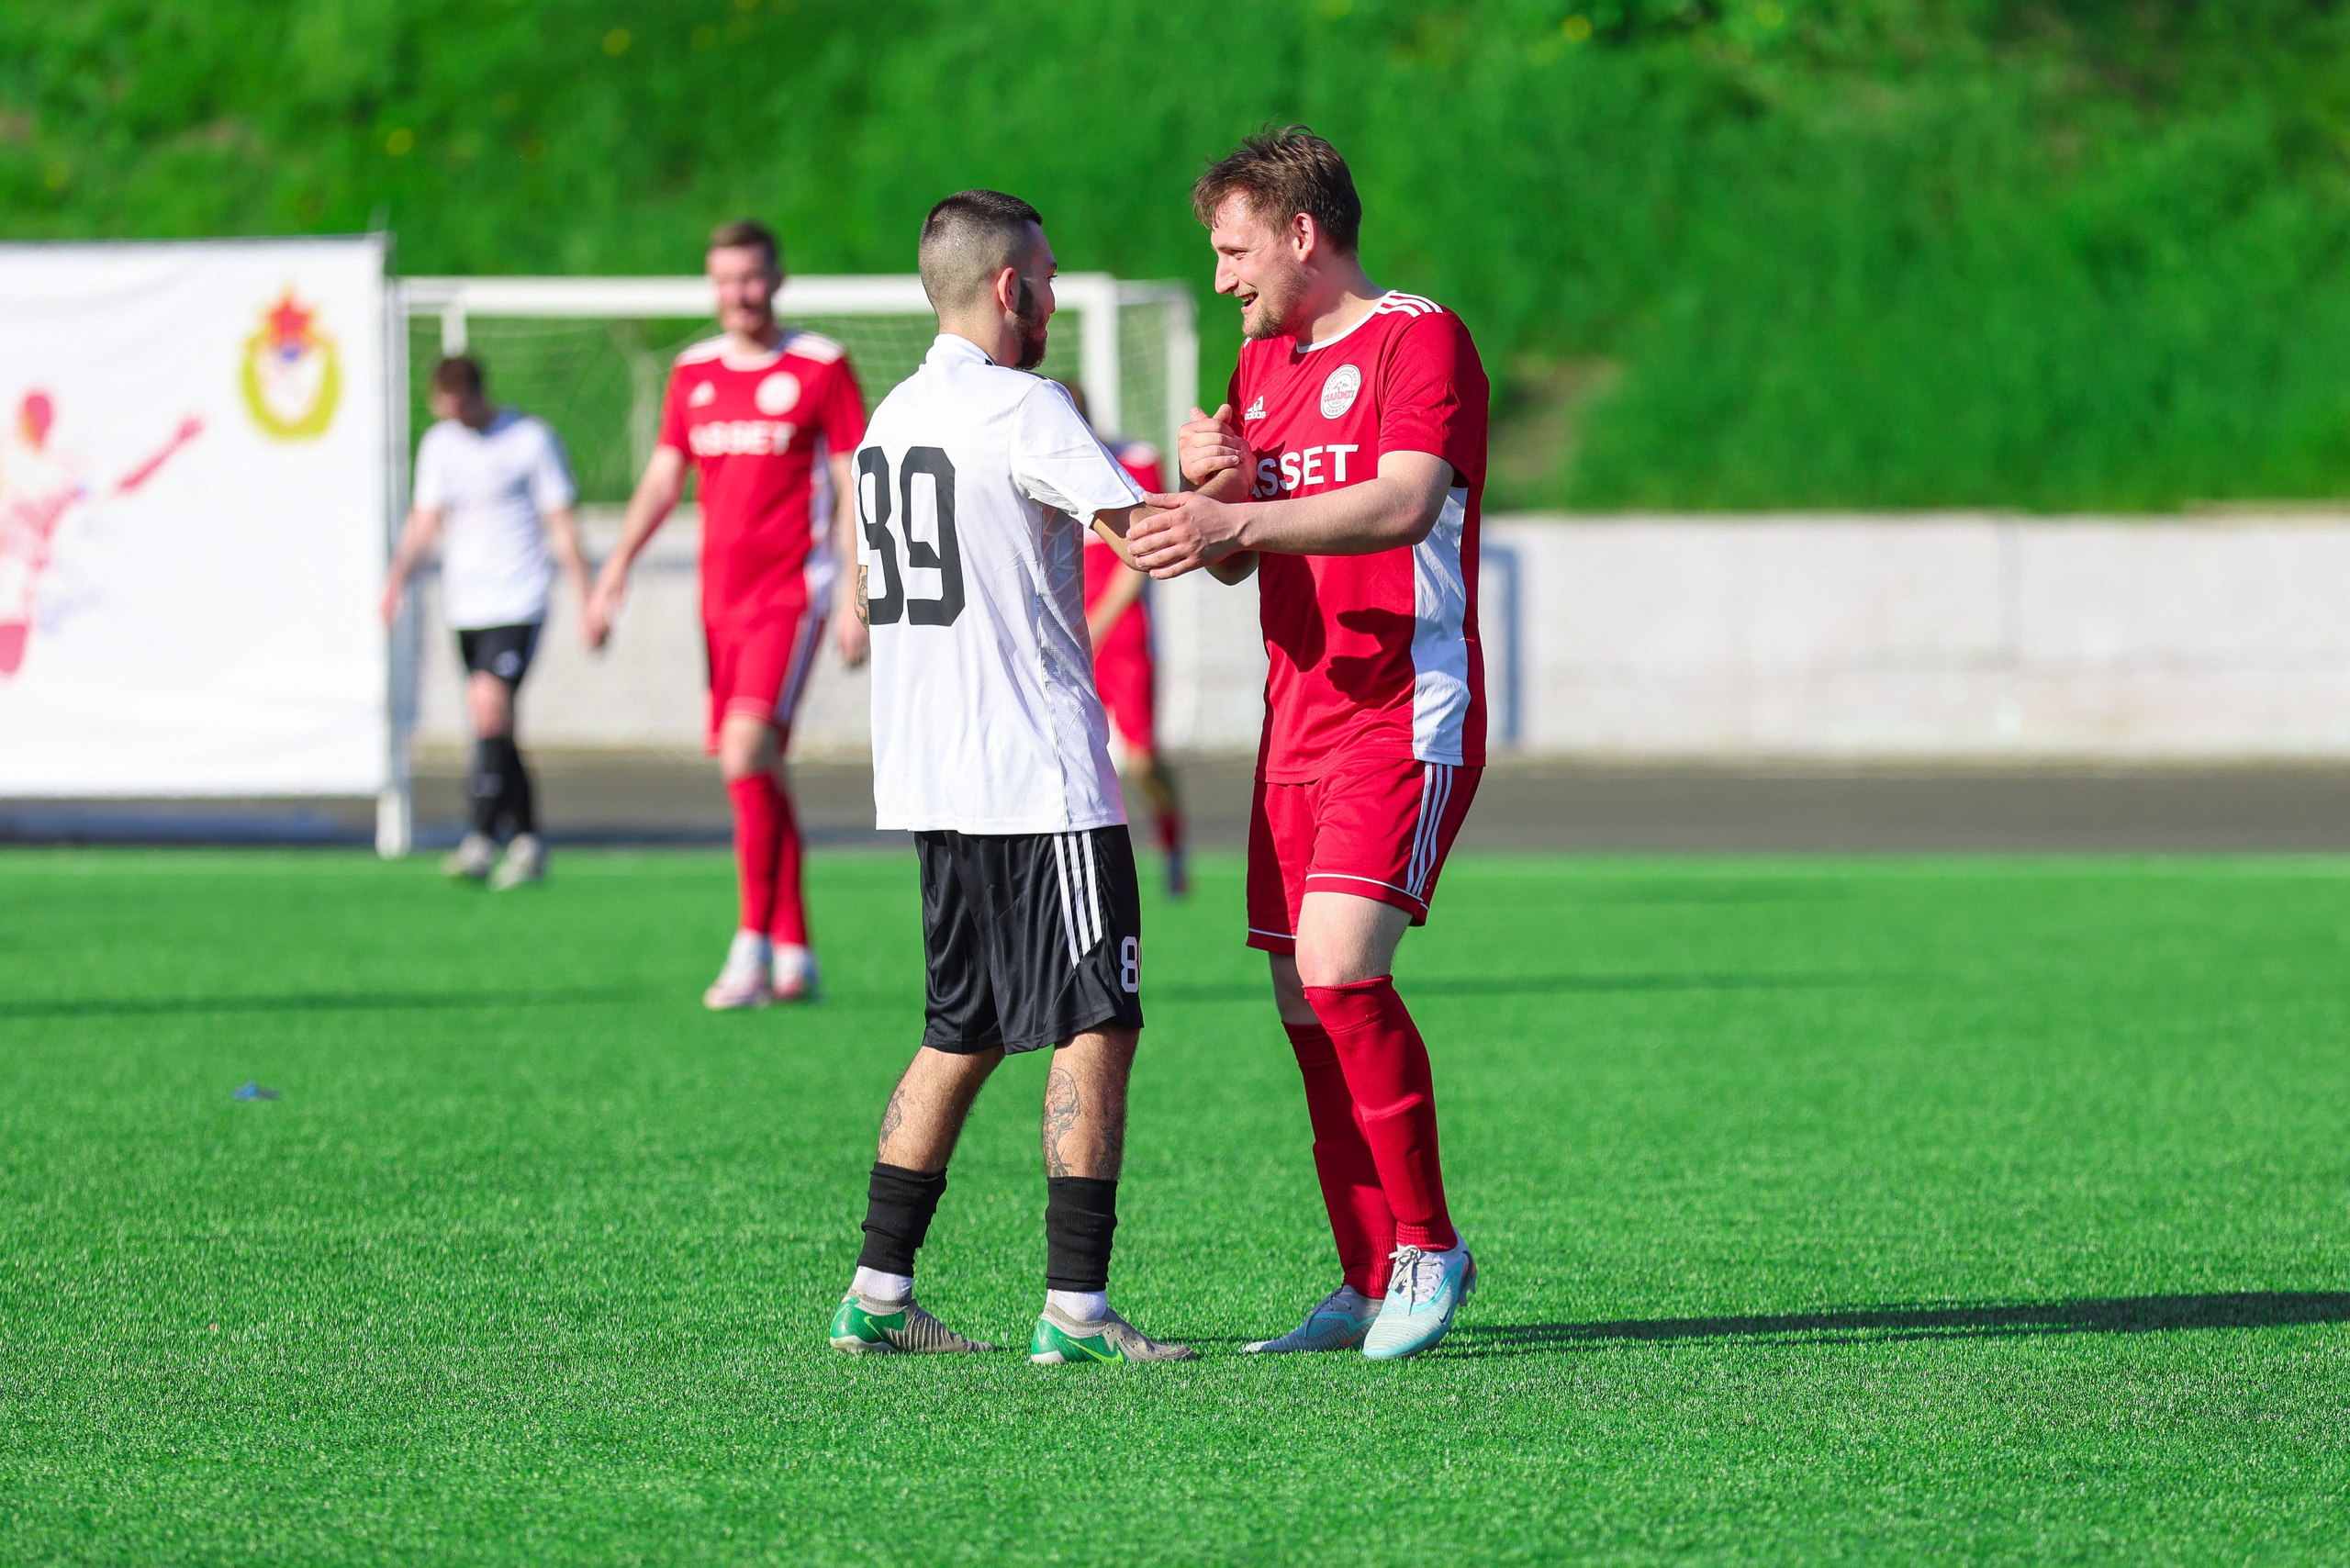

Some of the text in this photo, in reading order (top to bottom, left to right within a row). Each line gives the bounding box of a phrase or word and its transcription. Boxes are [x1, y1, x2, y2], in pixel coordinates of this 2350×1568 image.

[1244, 409, 1267, 420] adidas
[1250, 444, 1360, 498] SSET
[857, 446, 966, 626] 89
[1121, 935, 1142, 992] 8
